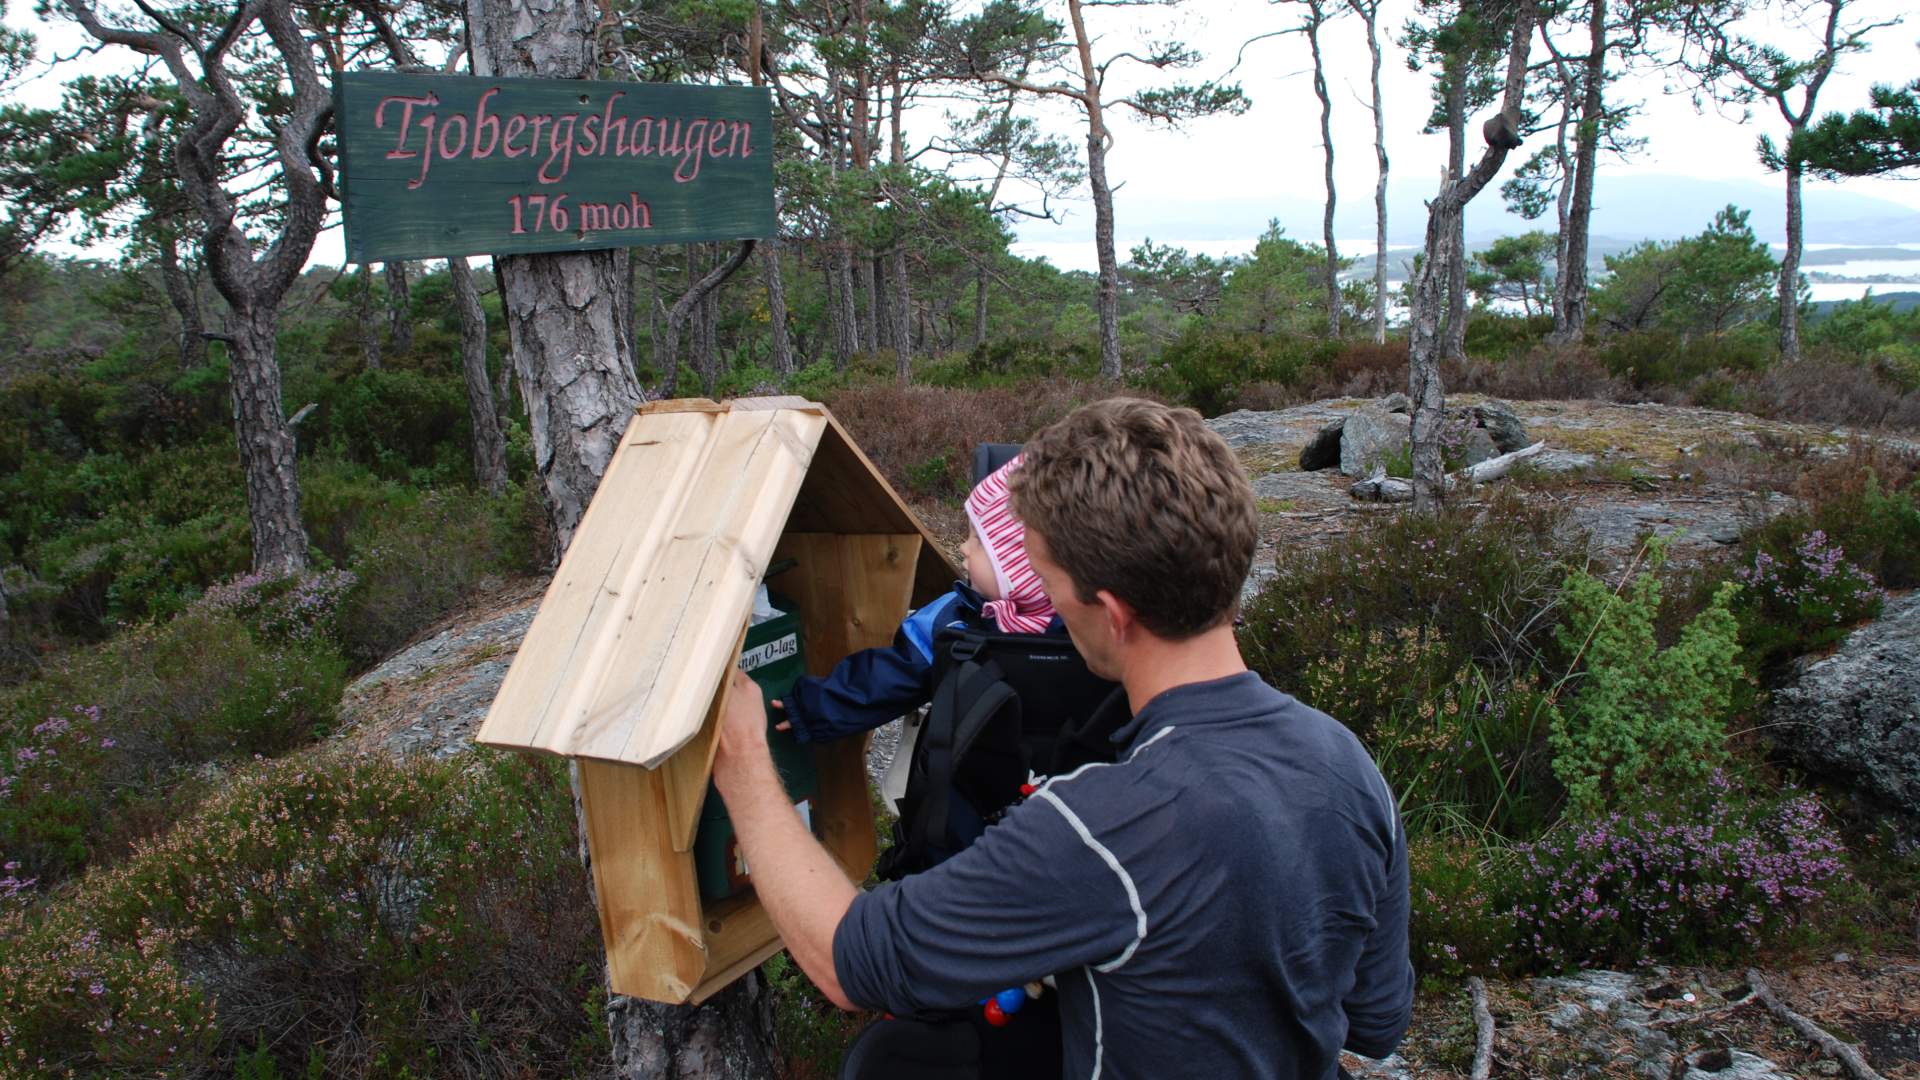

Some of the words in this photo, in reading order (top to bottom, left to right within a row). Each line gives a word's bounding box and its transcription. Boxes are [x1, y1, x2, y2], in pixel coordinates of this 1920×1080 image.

[374, 87, 754, 190] Tjobergshaugen
[508, 194, 568, 234] 176
[580, 191, 652, 232] moh
[765, 639, 796, 659] O-lag
